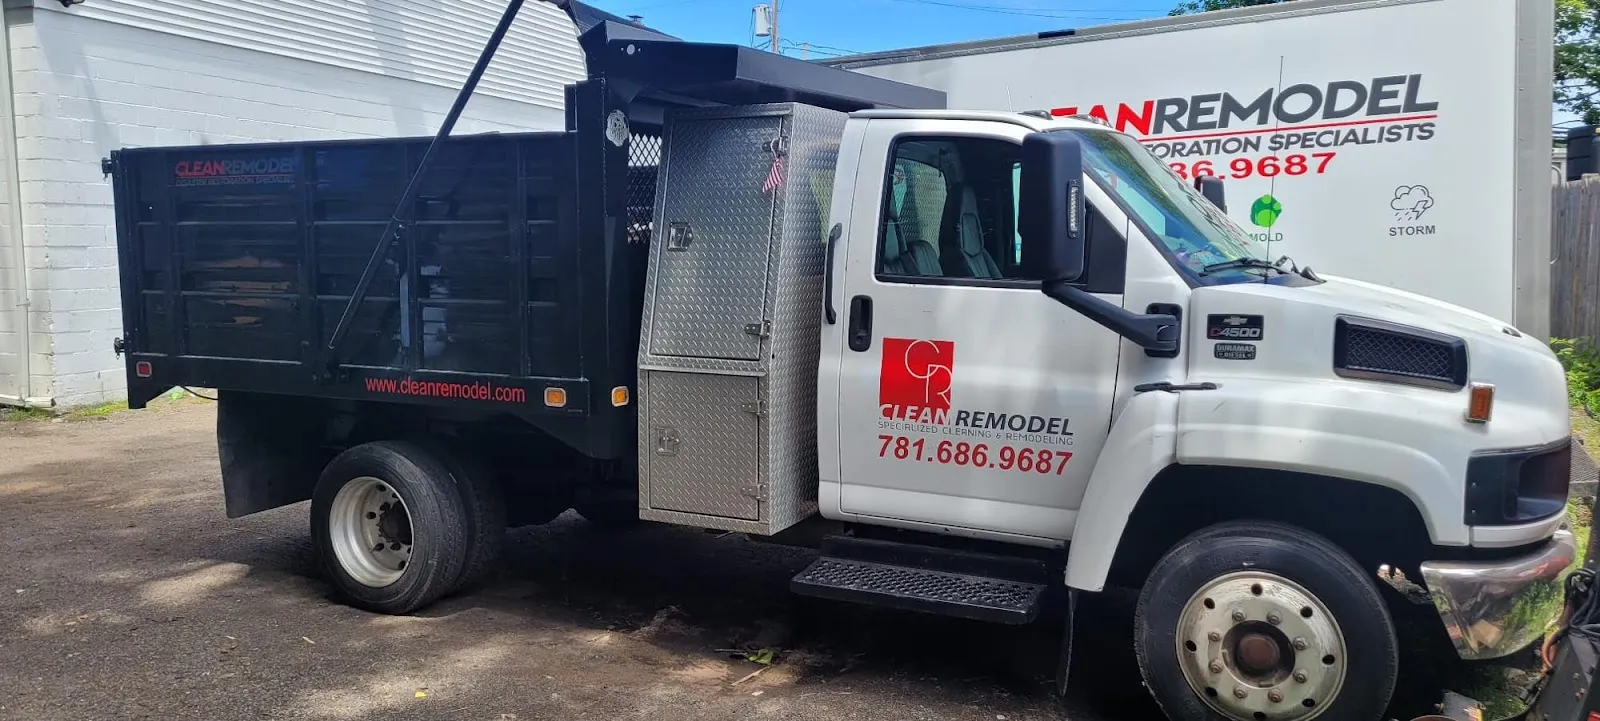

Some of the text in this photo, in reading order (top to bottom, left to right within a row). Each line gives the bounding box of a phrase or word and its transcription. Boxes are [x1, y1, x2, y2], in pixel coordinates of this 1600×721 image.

[1051, 74, 1439, 136] NREMODEL
[1268, 122, 1436, 151] SPECIALISTS
[1249, 232, 1283, 242] MOLD
[1389, 225, 1436, 236] STORM
[365, 376, 525, 402] www.cleanremodel.com
[878, 420, 938, 434] SPECIALIZED
[942, 426, 991, 439] CLEANING
[1005, 432, 1074, 446] REMODELING
[879, 403, 1074, 436] CLEAN REMODEL
[878, 434, 1073, 476] 781.686.9687
